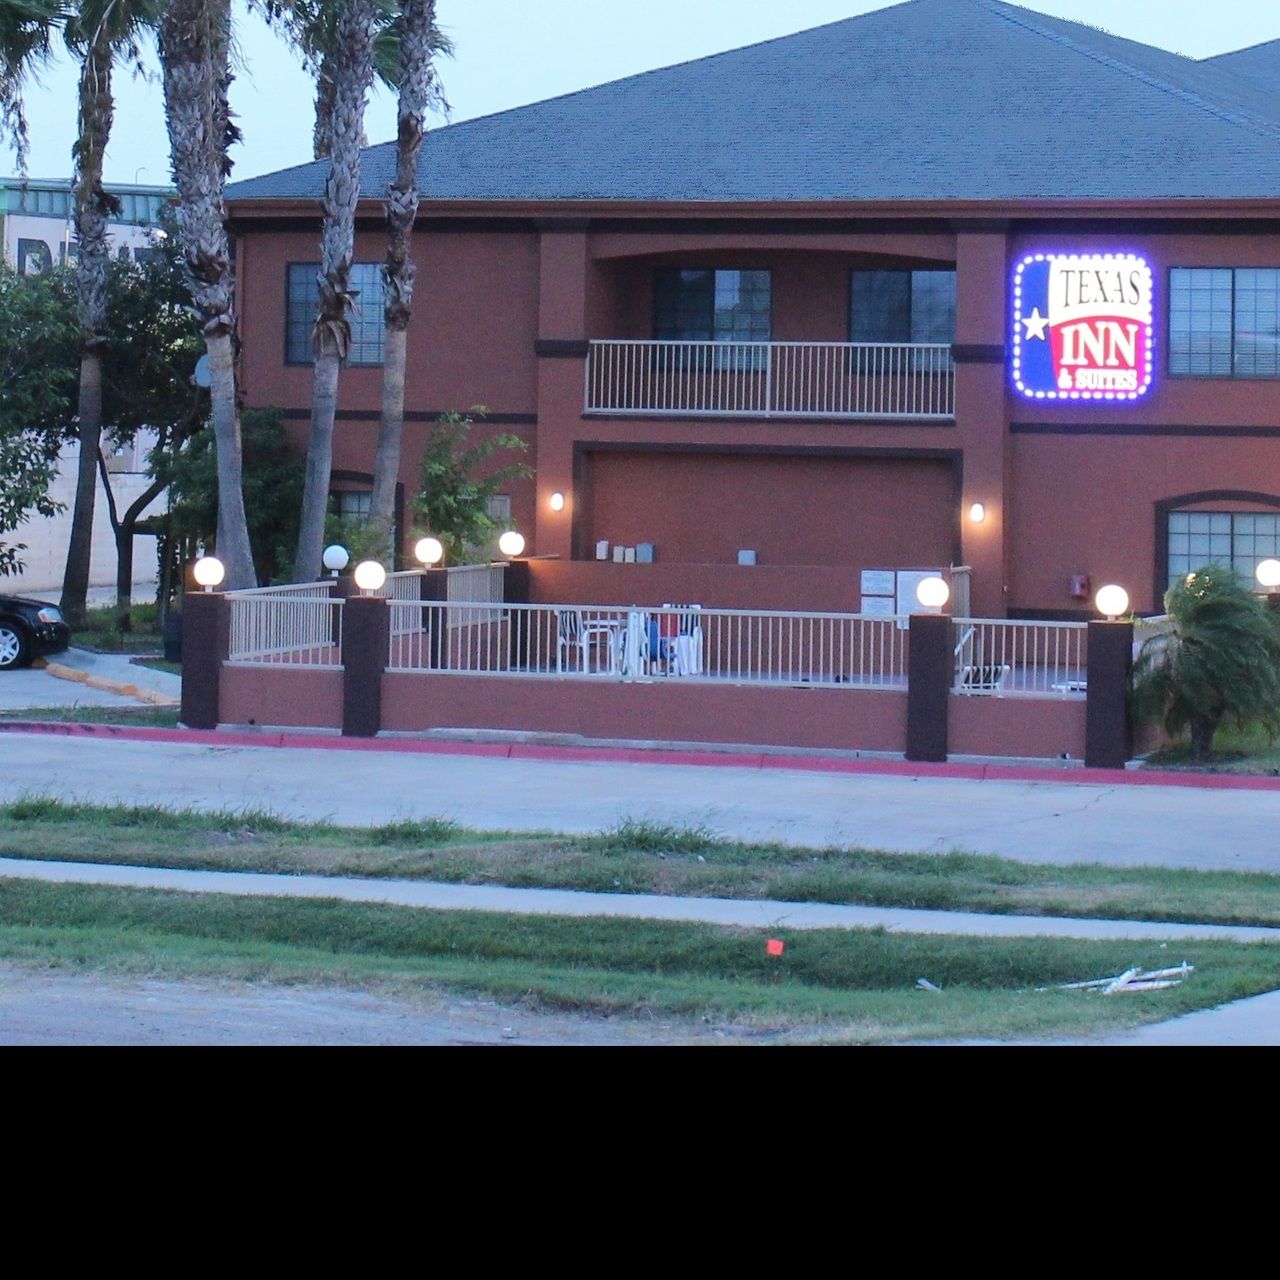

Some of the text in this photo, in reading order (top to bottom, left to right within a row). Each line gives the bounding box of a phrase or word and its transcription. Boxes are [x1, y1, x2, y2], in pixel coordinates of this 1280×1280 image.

[1059, 269, 1141, 308] TEXAS
[1059, 320, 1139, 368] INN
[1057, 367, 1138, 391] & SUITES
